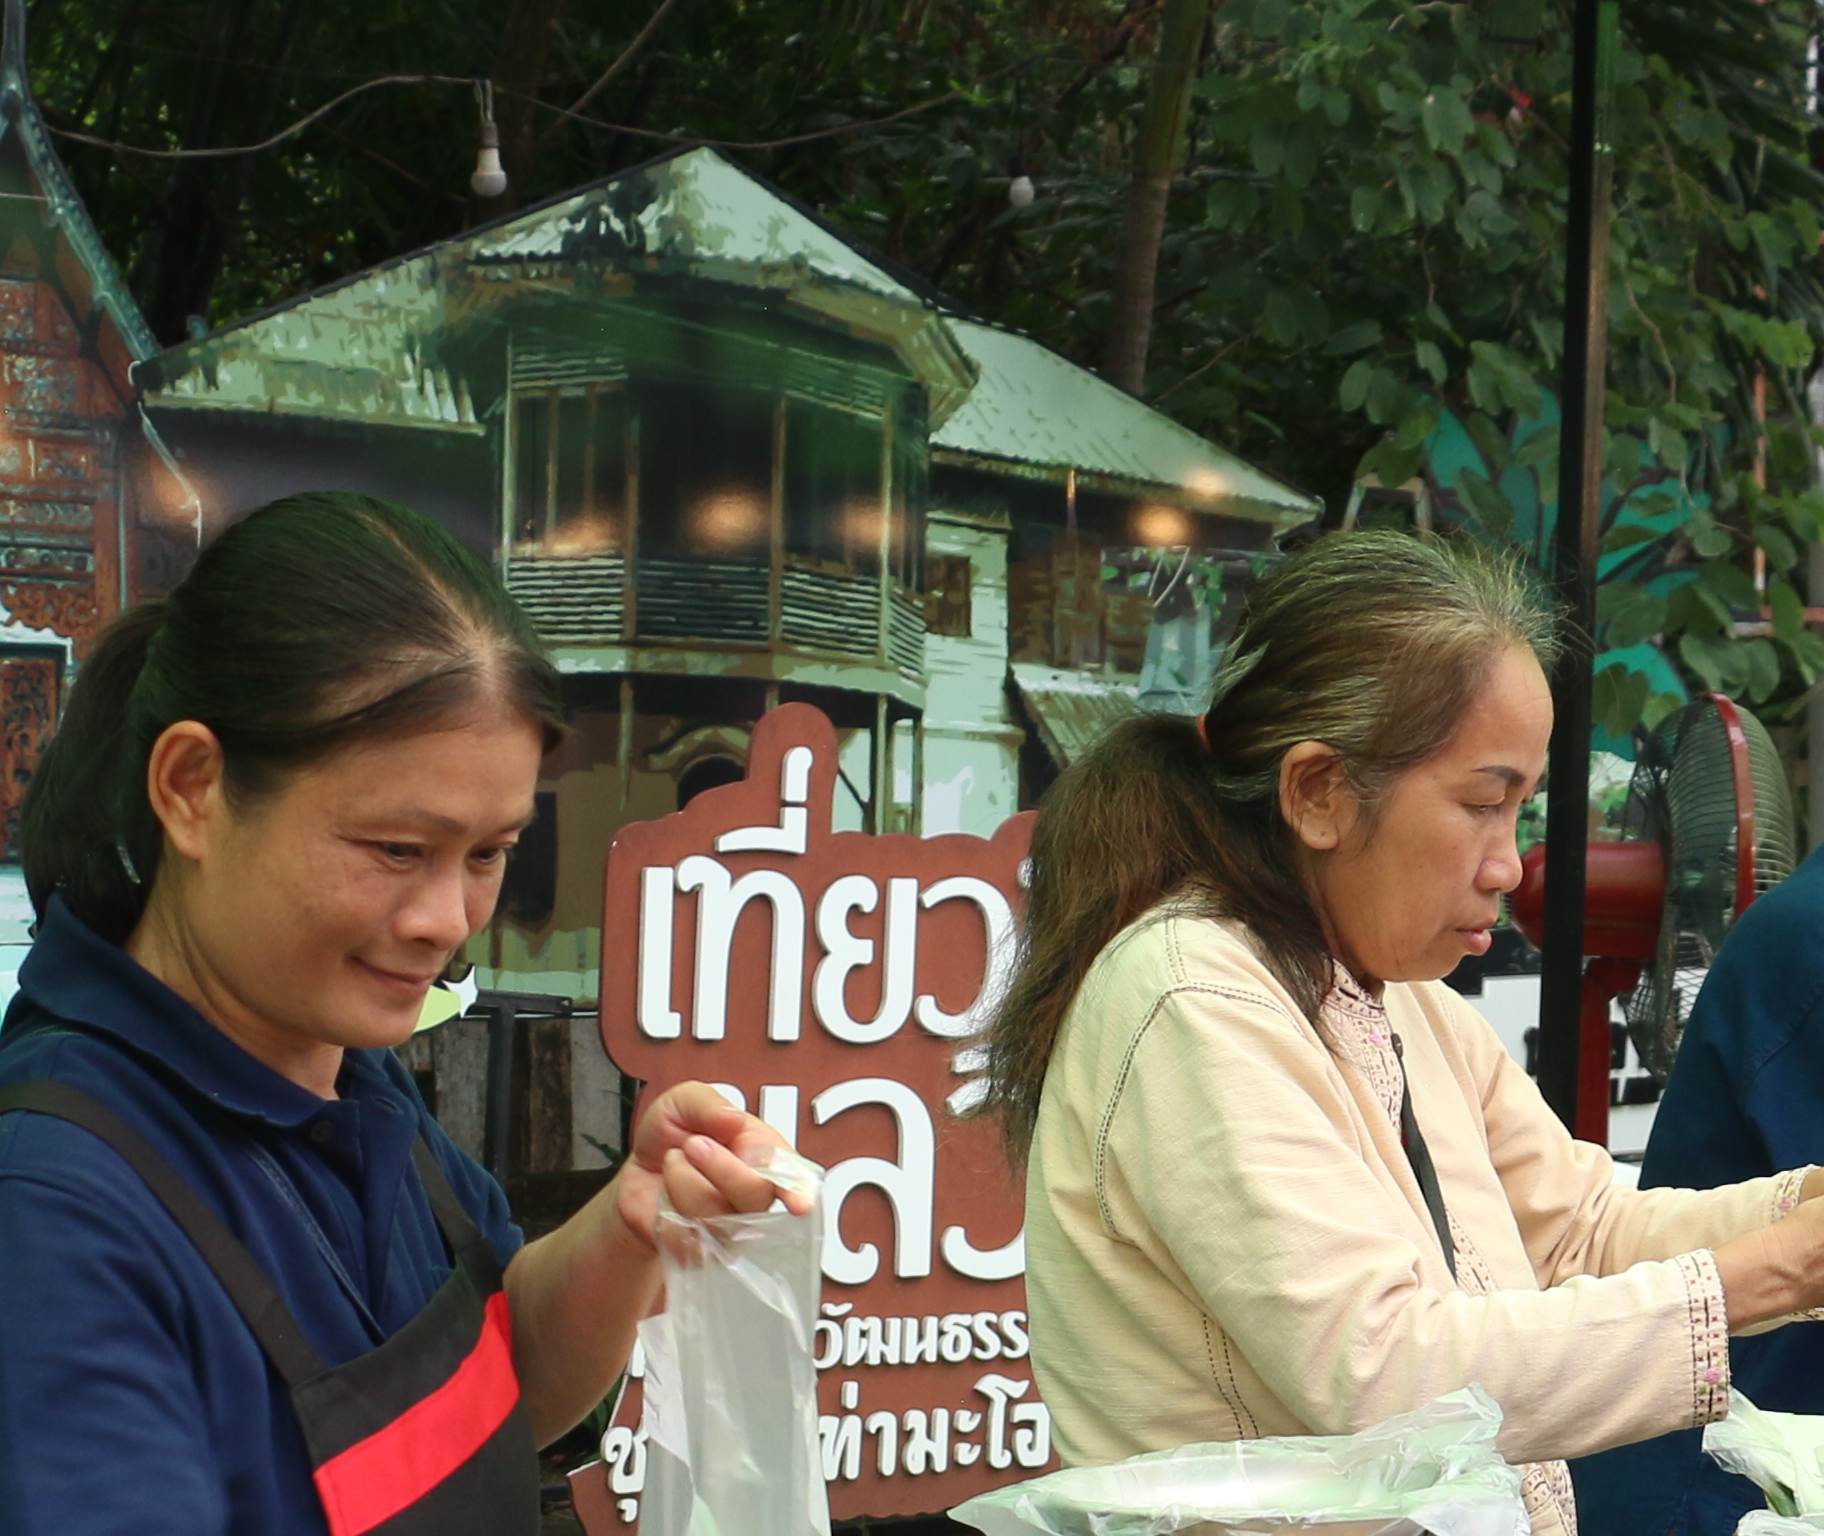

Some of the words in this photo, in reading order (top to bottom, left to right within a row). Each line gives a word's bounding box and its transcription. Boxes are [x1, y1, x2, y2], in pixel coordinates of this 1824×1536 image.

[637, 745, 1034, 1044] เที่ยว
[813, 1300, 1032, 1369] วัฒนธรร
